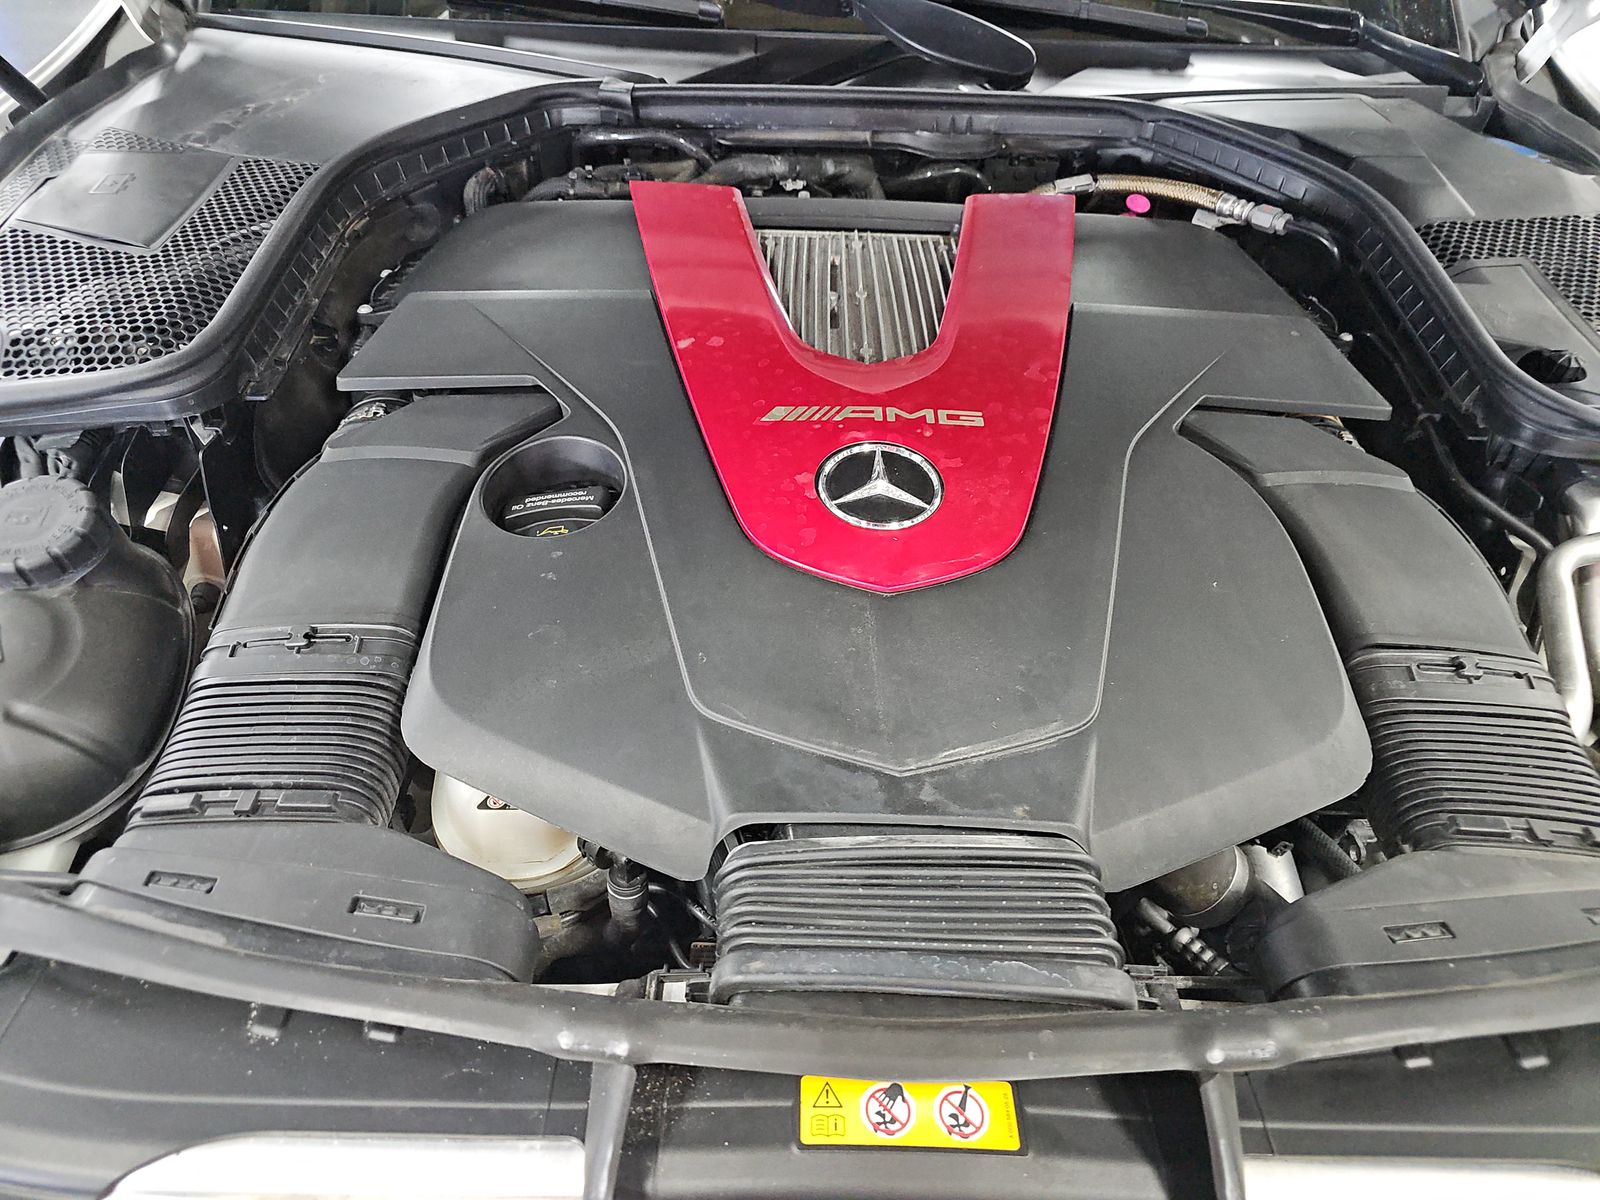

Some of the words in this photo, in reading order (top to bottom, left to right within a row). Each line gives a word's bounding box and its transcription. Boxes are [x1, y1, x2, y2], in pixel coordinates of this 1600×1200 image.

[832, 406, 984, 426] AMG
[525, 490, 587, 503] recommended
[526, 495, 594, 507] Mercedes-Benz
